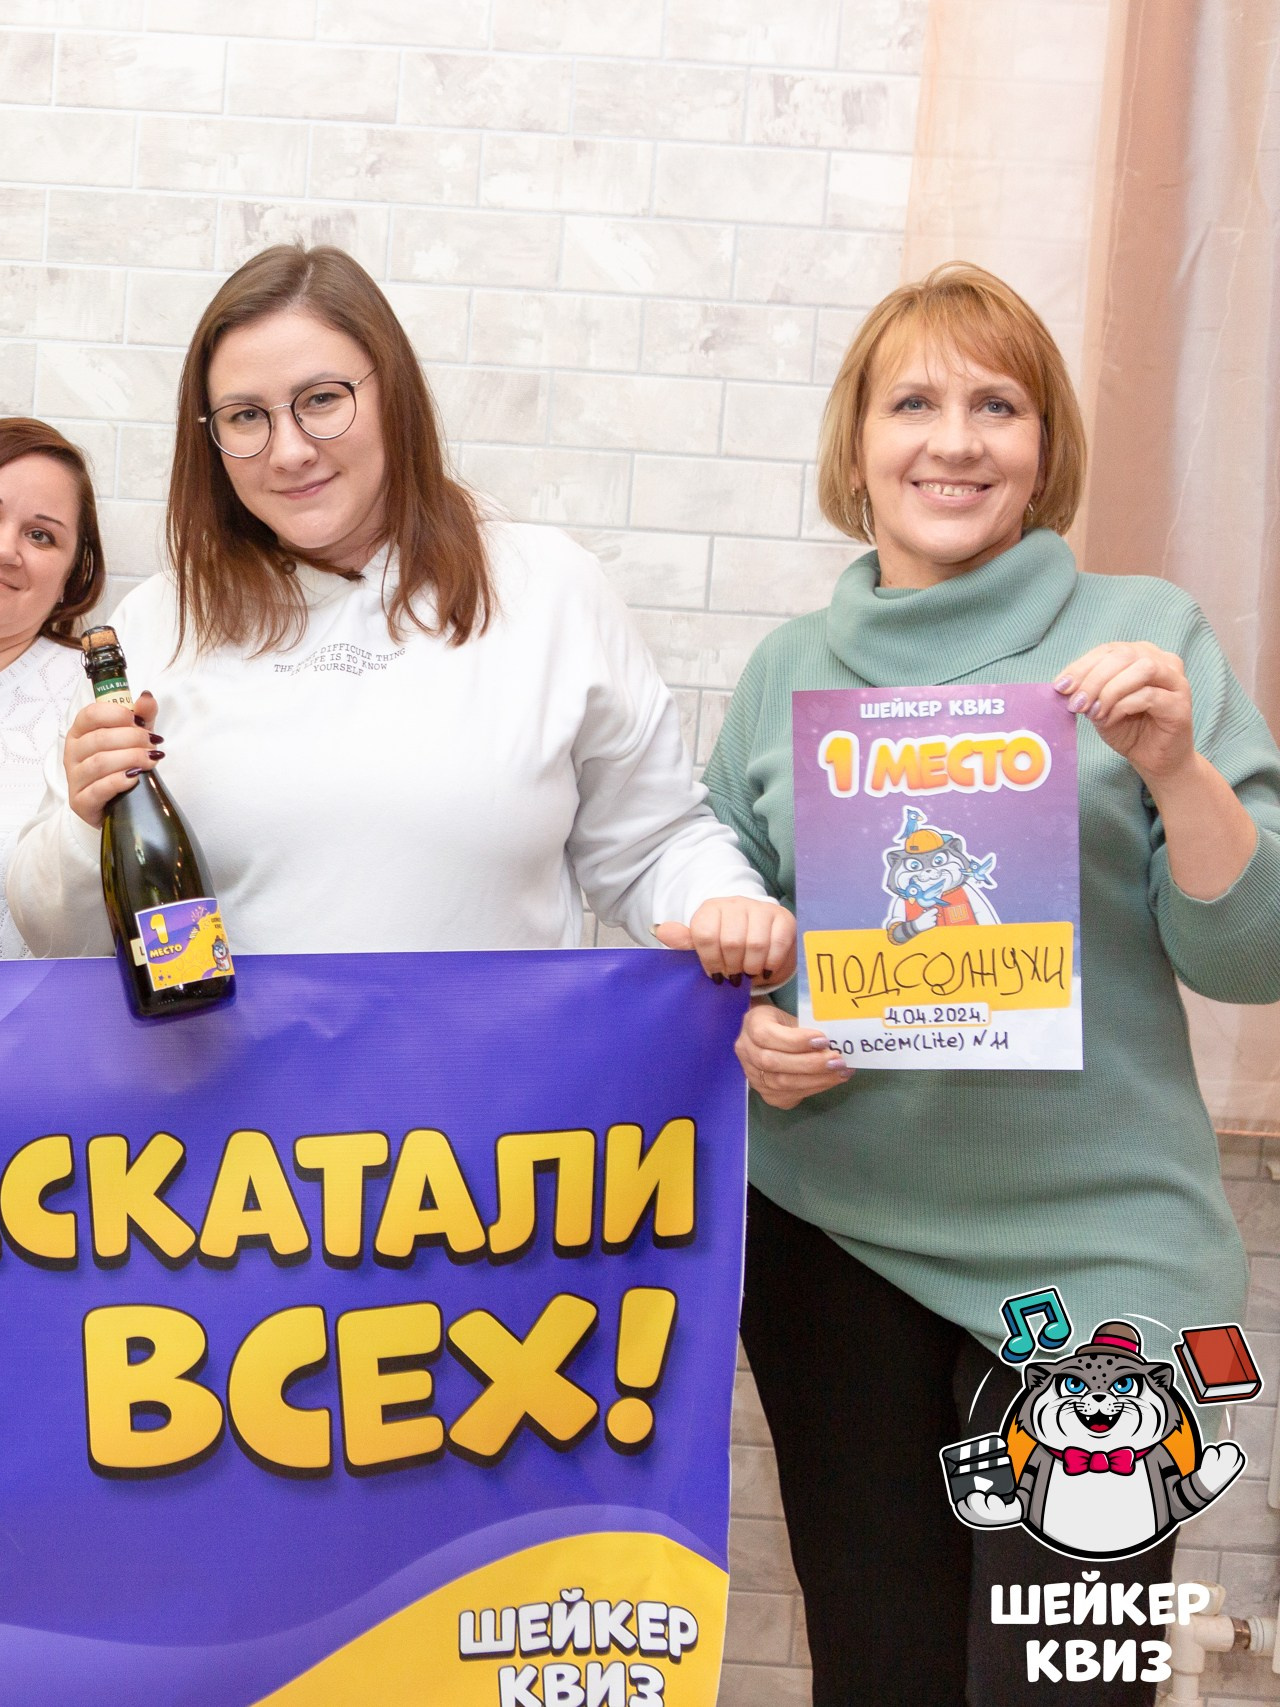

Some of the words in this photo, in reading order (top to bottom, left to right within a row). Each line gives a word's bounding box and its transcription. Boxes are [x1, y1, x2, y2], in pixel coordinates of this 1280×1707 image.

[274, 664, 294, 673] THE
[320, 643, 372, 660] DIFFICULT
[376, 647, 406, 661] THING
[313, 663, 364, 676] YOURSELF
[330, 653, 342, 661] IS
[347, 654, 358, 664] TO
[362, 660, 388, 671] KNOW
[97, 683, 115, 692] VILLA
[860, 697, 942, 718] ШЕЙКЕР
[948, 698, 1005, 716] КВИЗ
[823, 736, 854, 793] 1
[870, 736, 1046, 792] МЕСТО
[150, 913, 169, 944] 1
[150, 944, 182, 958] МЕСТО
[816, 946, 1065, 1008] ПОДСОЛНУХИ
[82, 1286, 678, 1479] ВСЕХ!
[459, 1587, 699, 1663] ШЕЙКЕР
[498, 1661, 665, 1707] КВИЗ
